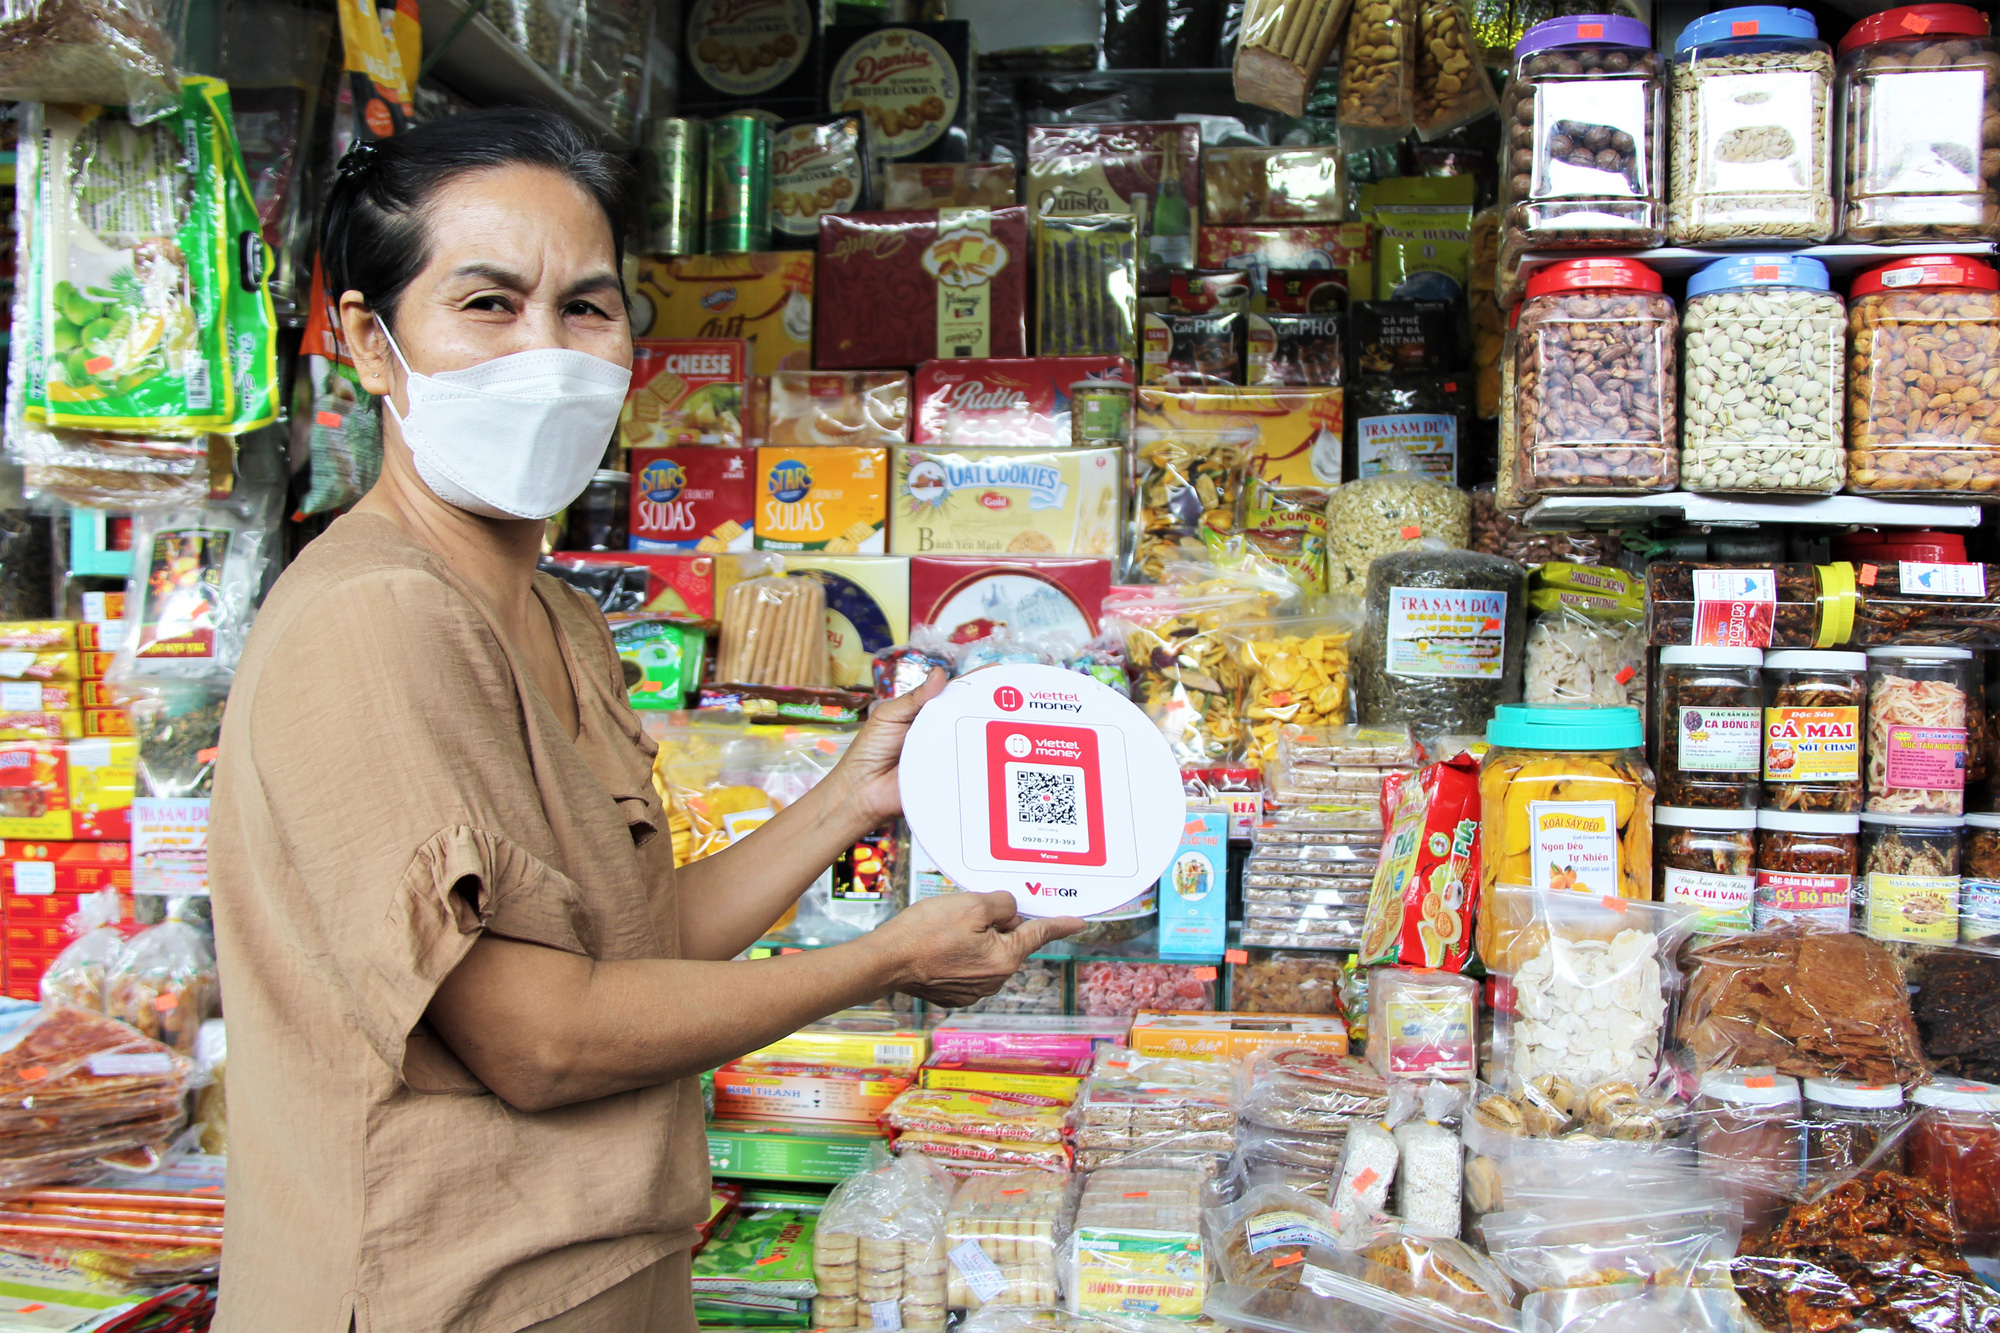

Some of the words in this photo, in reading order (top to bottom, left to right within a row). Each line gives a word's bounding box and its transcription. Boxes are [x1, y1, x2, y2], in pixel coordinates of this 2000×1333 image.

[849, 46, 934, 85] Danisa
[891, 85, 937, 95] COOKIES
[1382, 315, 1396, 325] CÀ
[1400, 315, 1419, 325] PHÊ
[1172, 323, 1194, 334] Cafe
[1277, 324, 1299, 334] Cafe
[1383, 326, 1403, 334] ĐEN
[1407, 324, 1420, 334] ĐÁ
[1402, 336, 1425, 344] NAM
[665, 354, 731, 374] CHEESE
[1364, 421, 1388, 437] TRÀ
[637, 466, 688, 496] STARS
[765, 465, 816, 496] STARS
[948, 464, 981, 486] OAT
[986, 464, 1058, 489] COOKIES
[684, 489, 715, 500] CRUNCHY
[811, 489, 844, 500] CRUNCHY
[984, 497, 1007, 507] Gold
[638, 500, 696, 532] SODAS
[765, 500, 825, 532] SODAS
[1400, 593, 1428, 611] TRÀ
[1471, 595, 1500, 613] DỨA
[1731, 602, 1746, 617] Cá
[1729, 618, 1745, 638] Kèo
[1029, 691, 1080, 702] viettel
[1029, 701, 1082, 713] money
[1813, 710, 1835, 718] Sản
[1705, 718, 1718, 728] CÁ
[1721, 717, 1748, 729] BỐNG
[1769, 720, 1799, 738] CÁ
[1807, 724, 1852, 737] MAI
[1035, 739, 1080, 750] viettel
[1798, 739, 1820, 752] SỐT
[1824, 743, 1856, 752] CHANH
[0, 751, 32, 767] ANH
[1035, 748, 1082, 760] money
[1543, 816, 1564, 829] XOÀI
[1565, 816, 1582, 828] SẤY
[1583, 818, 1600, 832] DẺO
[1022, 836, 1076, 846] 0978-773-393
[1451, 818, 1477, 858] PÍA
[1541, 843, 1564, 852] Ngon
[1567, 841, 1584, 850] Dẻo
[1569, 854, 1580, 863] Tự
[1582, 853, 1609, 862] Nhiên
[1679, 876, 1695, 884] Đặc
[1769, 875, 1783, 885] ĐẶC
[1784, 876, 1800, 886] SẢN
[1801, 877, 1812, 887] ĐÀ
[1814, 877, 1835, 887] NẴNG
[1025, 881, 1078, 898] VIETQR
[1674, 885, 1690, 896] CÁ
[1694, 887, 1717, 899] CHỈ
[1721, 889, 1748, 901] VÀNG
[1775, 887, 1795, 903] CÁ
[1799, 888, 1820, 904] BÒ
[947, 1037, 965, 1046] ĐẶC
[967, 1036, 985, 1046] SẢN
[726, 1085, 752, 1096] KIM
[755, 1087, 801, 1098] THANH
[776, 1223, 805, 1244] NGỌC
